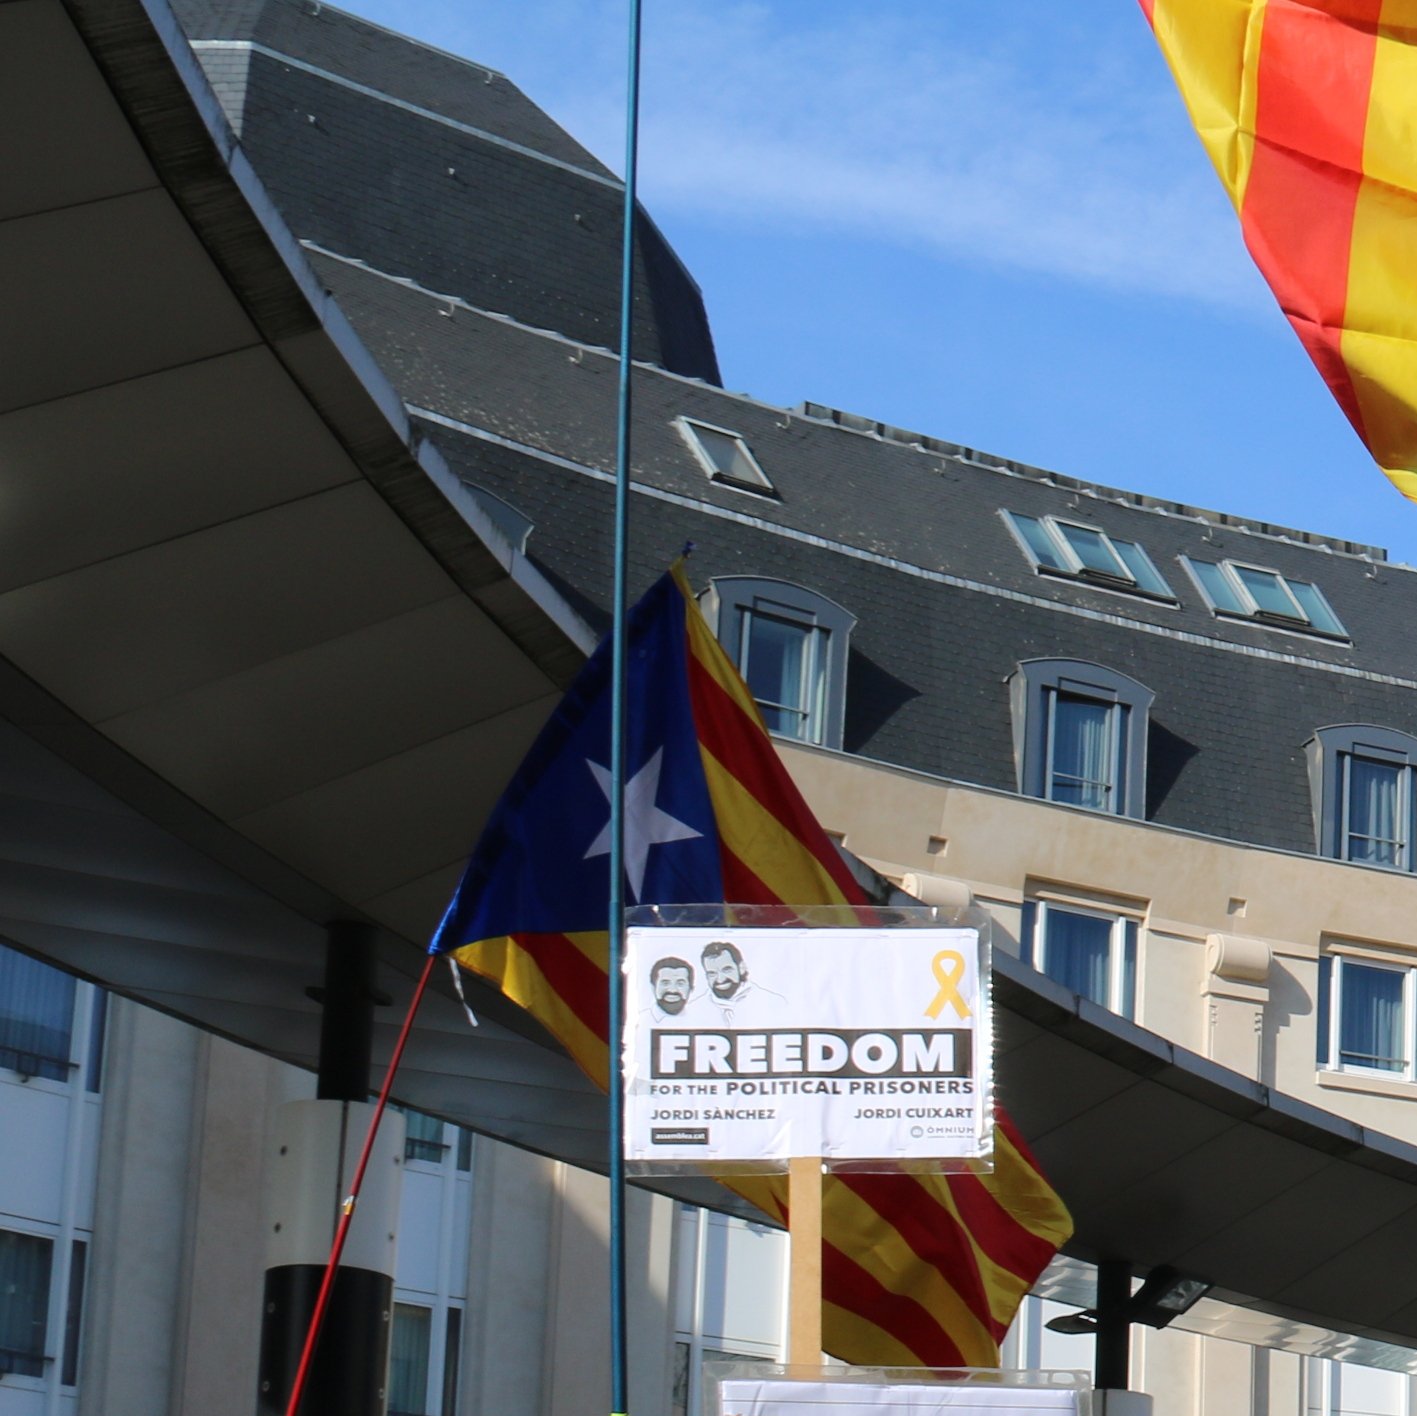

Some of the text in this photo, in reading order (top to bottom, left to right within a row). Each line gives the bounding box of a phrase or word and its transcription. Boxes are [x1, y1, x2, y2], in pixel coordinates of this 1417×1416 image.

[658, 1033, 954, 1074] FREEDOM
[650, 1080, 974, 1096] FOR THE POLITICAL PRISONERS
[650, 1106, 775, 1121] JORDI SÀNCHEZ
[854, 1108, 974, 1119] JORDI CUIXART
